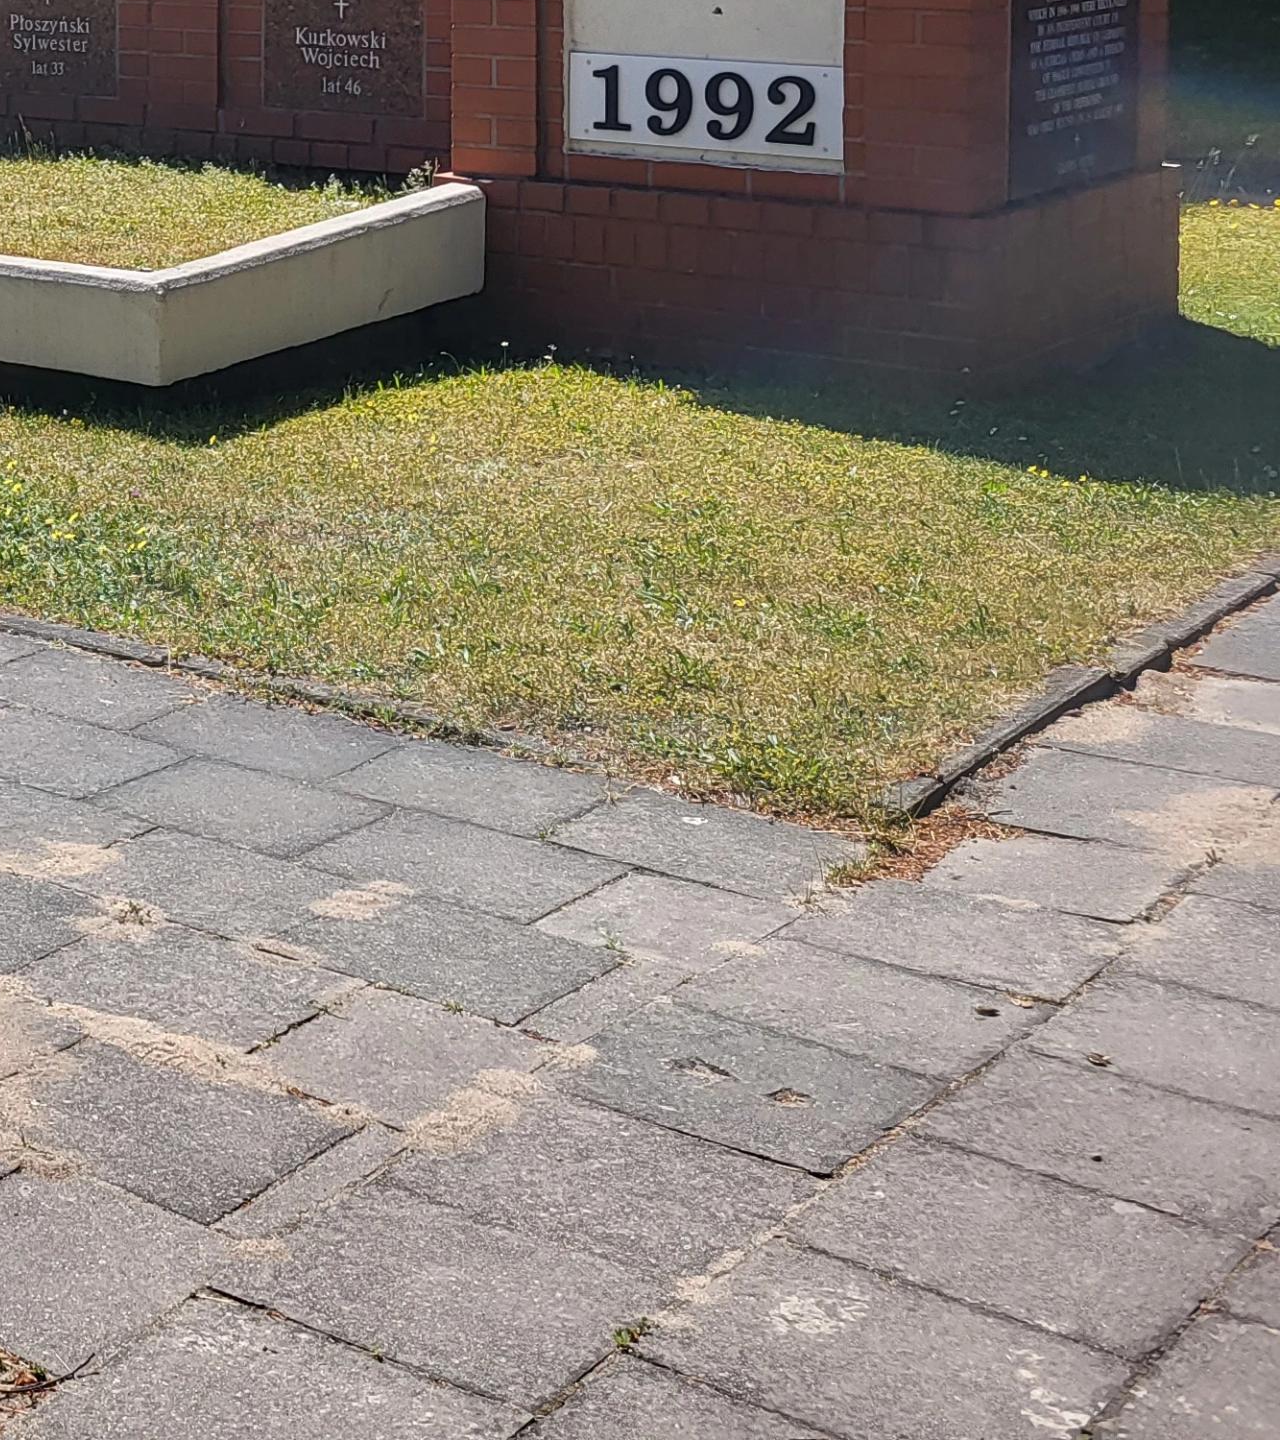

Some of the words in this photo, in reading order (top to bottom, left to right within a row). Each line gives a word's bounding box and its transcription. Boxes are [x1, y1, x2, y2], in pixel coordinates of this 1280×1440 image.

[10, 14, 90, 35] Płoszyński
[14, 33, 88, 53] Sylwester
[295, 26, 386, 50] Kurkowski
[32, 60, 48, 75] lat
[50, 61, 65, 76] 33
[300, 47, 381, 70] Wojciech
[322, 76, 342, 93] lat
[344, 77, 362, 95] 46
[592, 64, 816, 147] 1992
